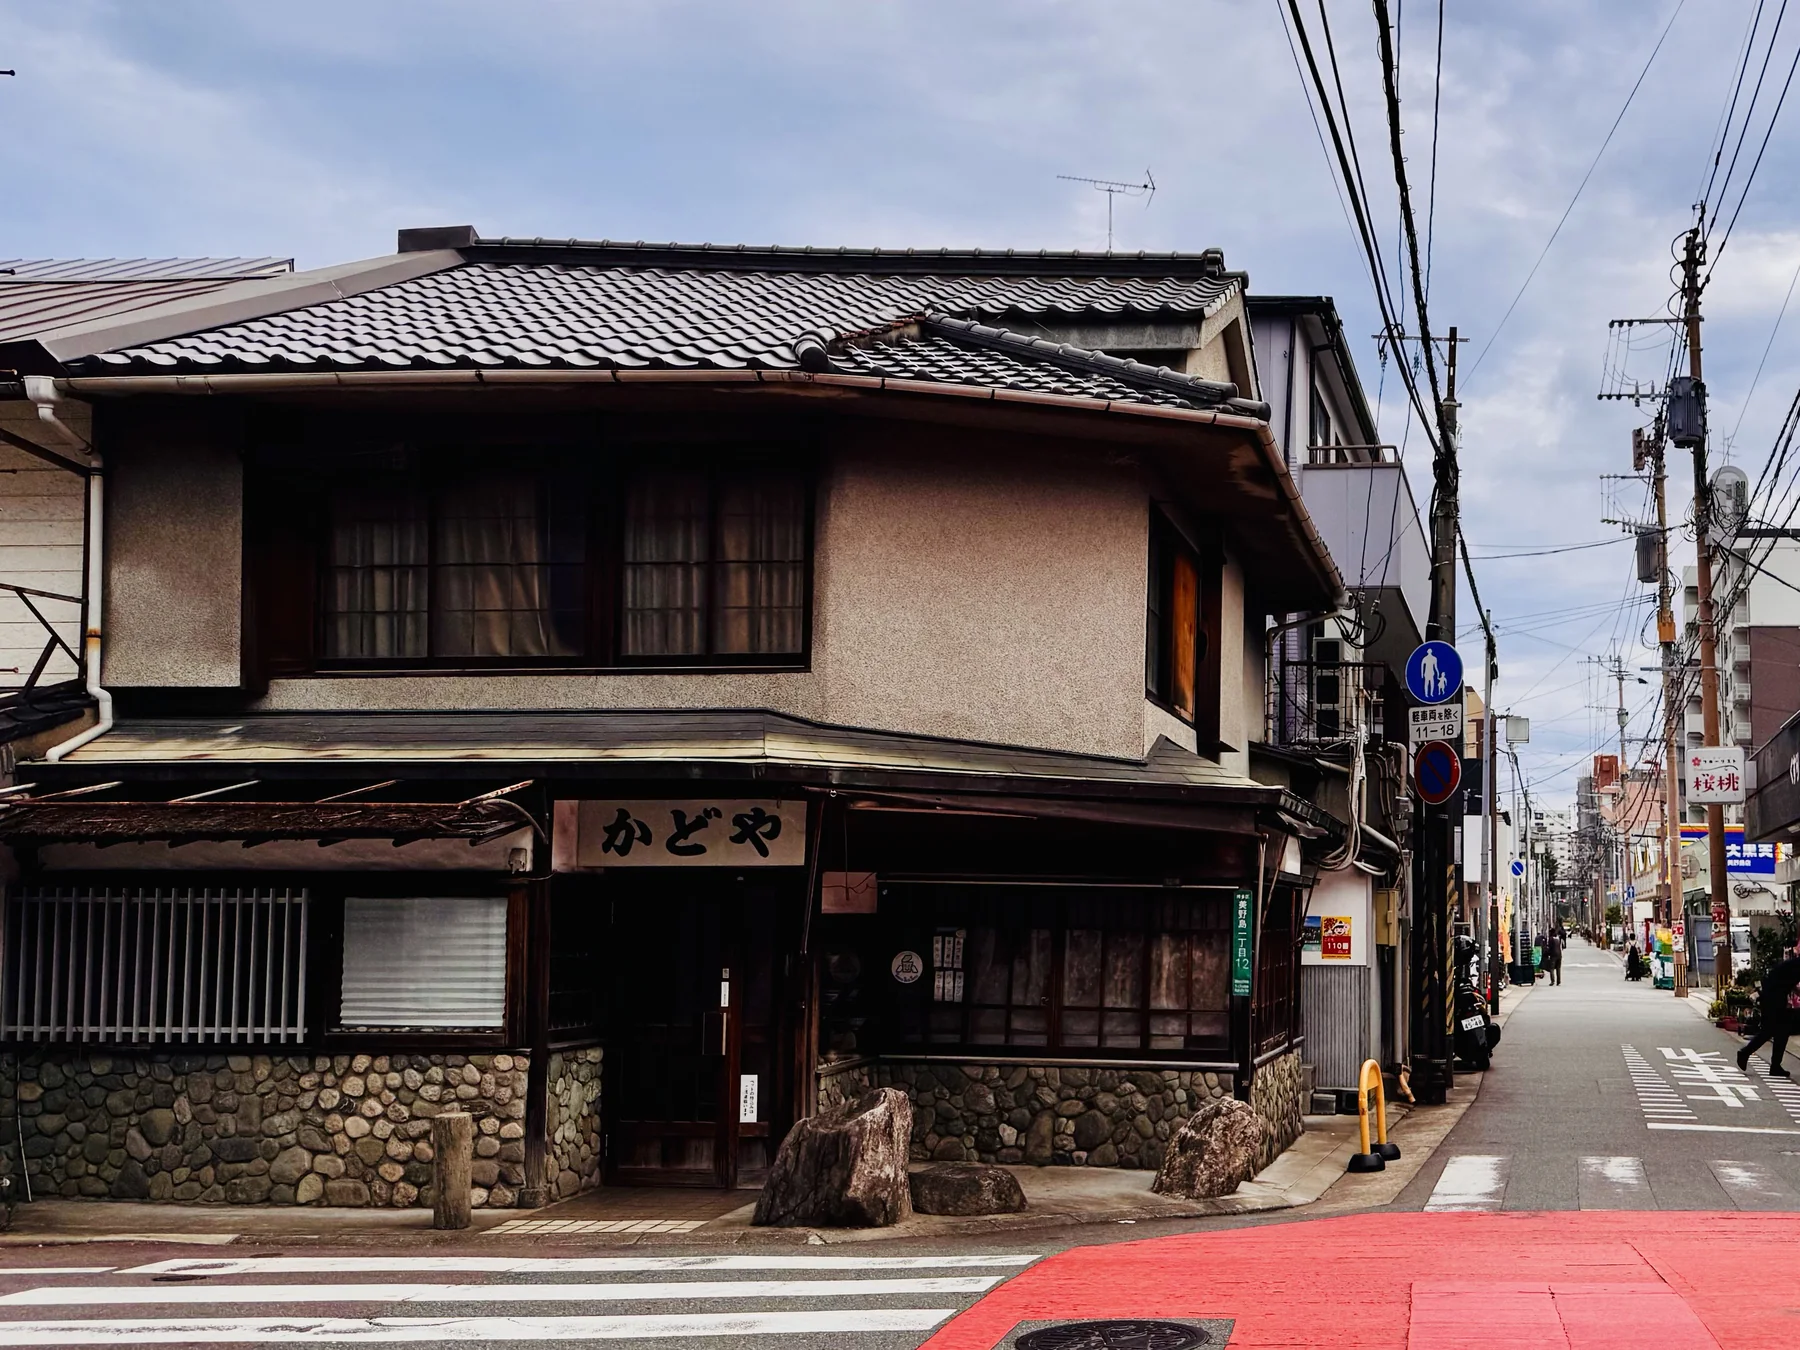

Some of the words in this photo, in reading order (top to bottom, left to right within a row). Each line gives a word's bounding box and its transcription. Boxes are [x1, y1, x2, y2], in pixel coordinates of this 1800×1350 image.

[1412, 708, 1458, 723] 軽車両を除く
[1693, 773, 1740, 793] 桜桃
[601, 807, 782, 858] かどや
